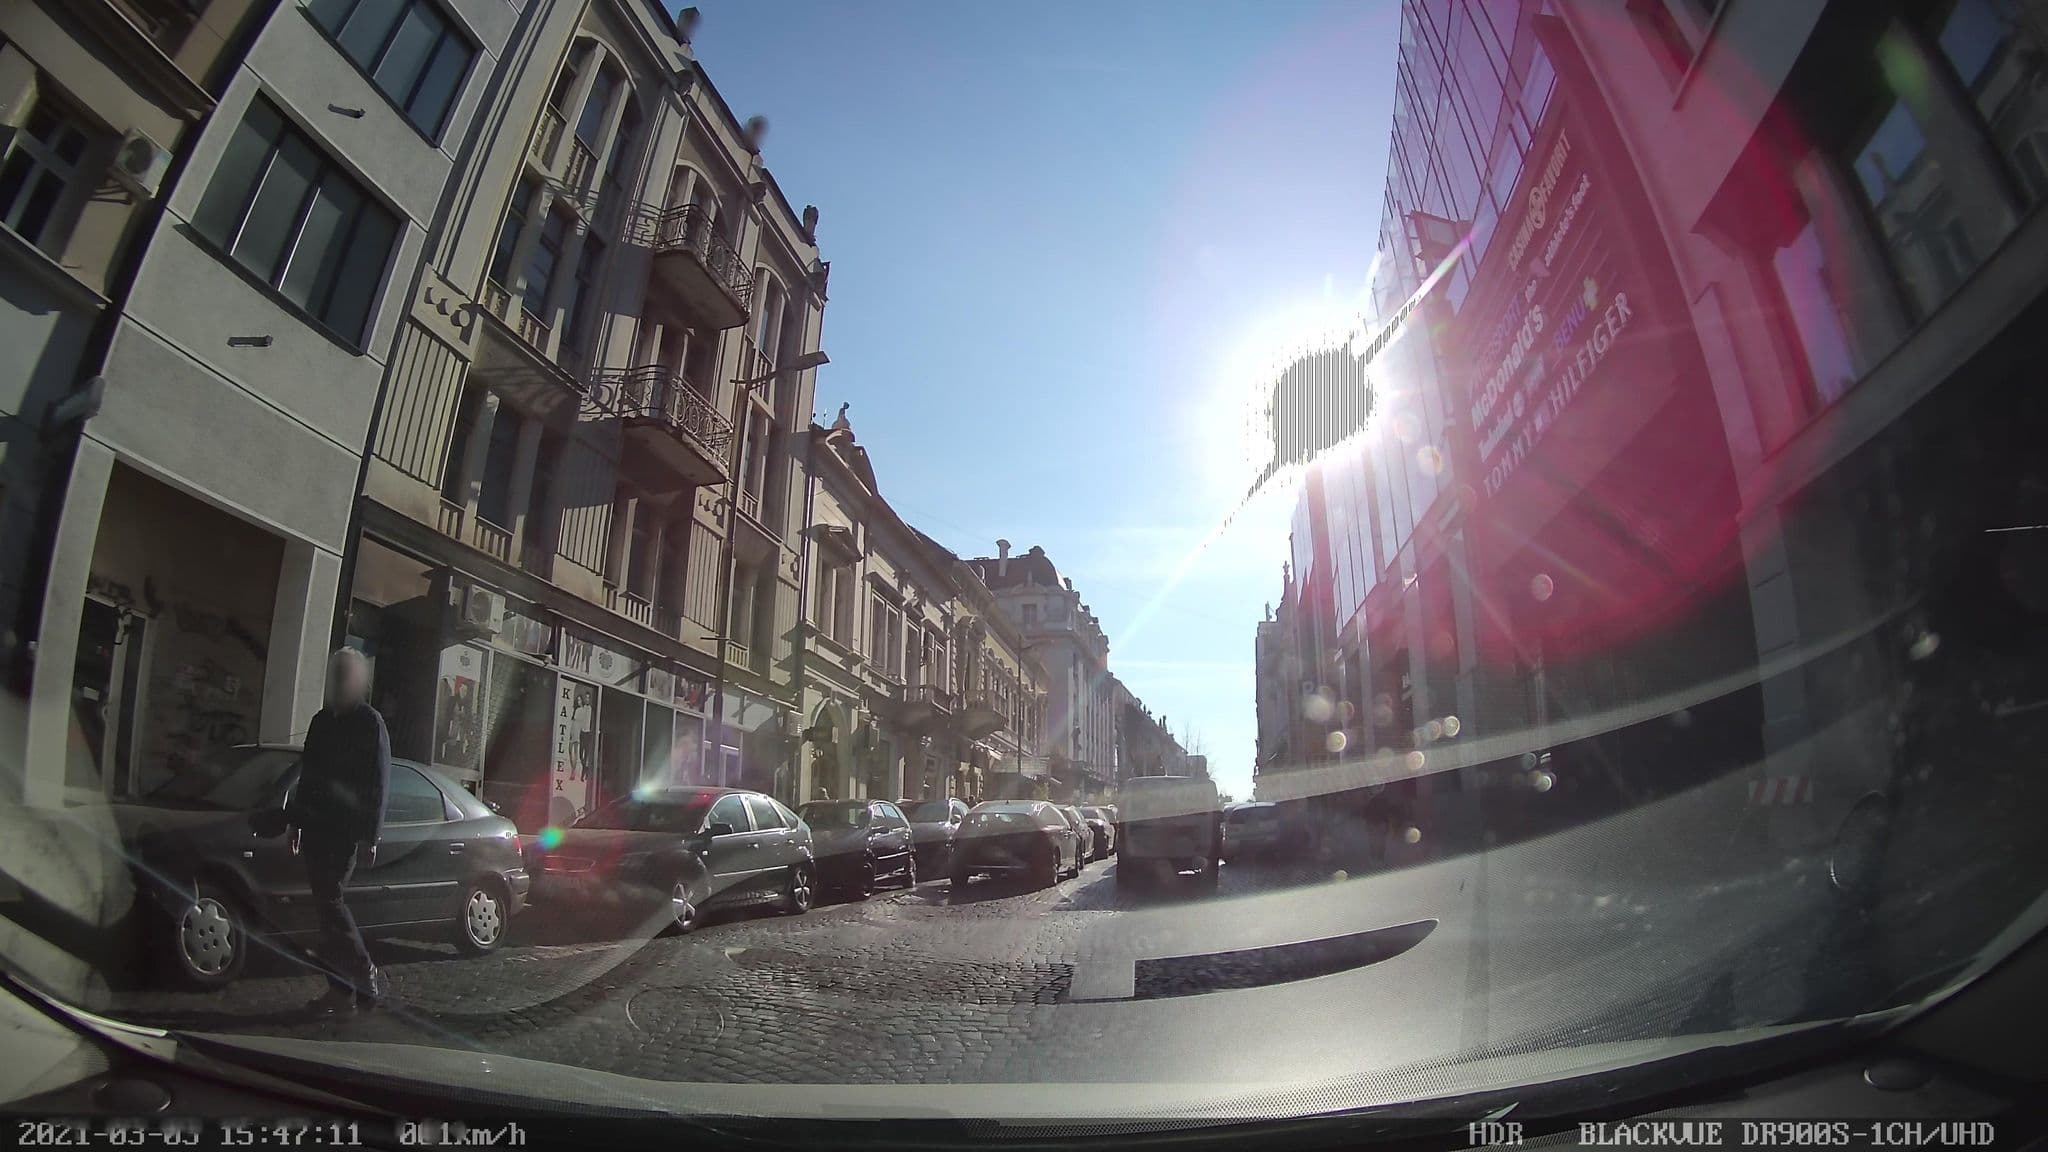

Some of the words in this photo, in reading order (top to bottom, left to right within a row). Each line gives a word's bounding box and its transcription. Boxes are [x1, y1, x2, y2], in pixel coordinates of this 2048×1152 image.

[1539, 127, 1572, 203] FAVORIT
[1471, 303, 1544, 433] McDonald's
[1554, 296, 1588, 352] BENU
[1482, 420, 1533, 499] TOMMY
[1548, 291, 1632, 417] HILFIGER
